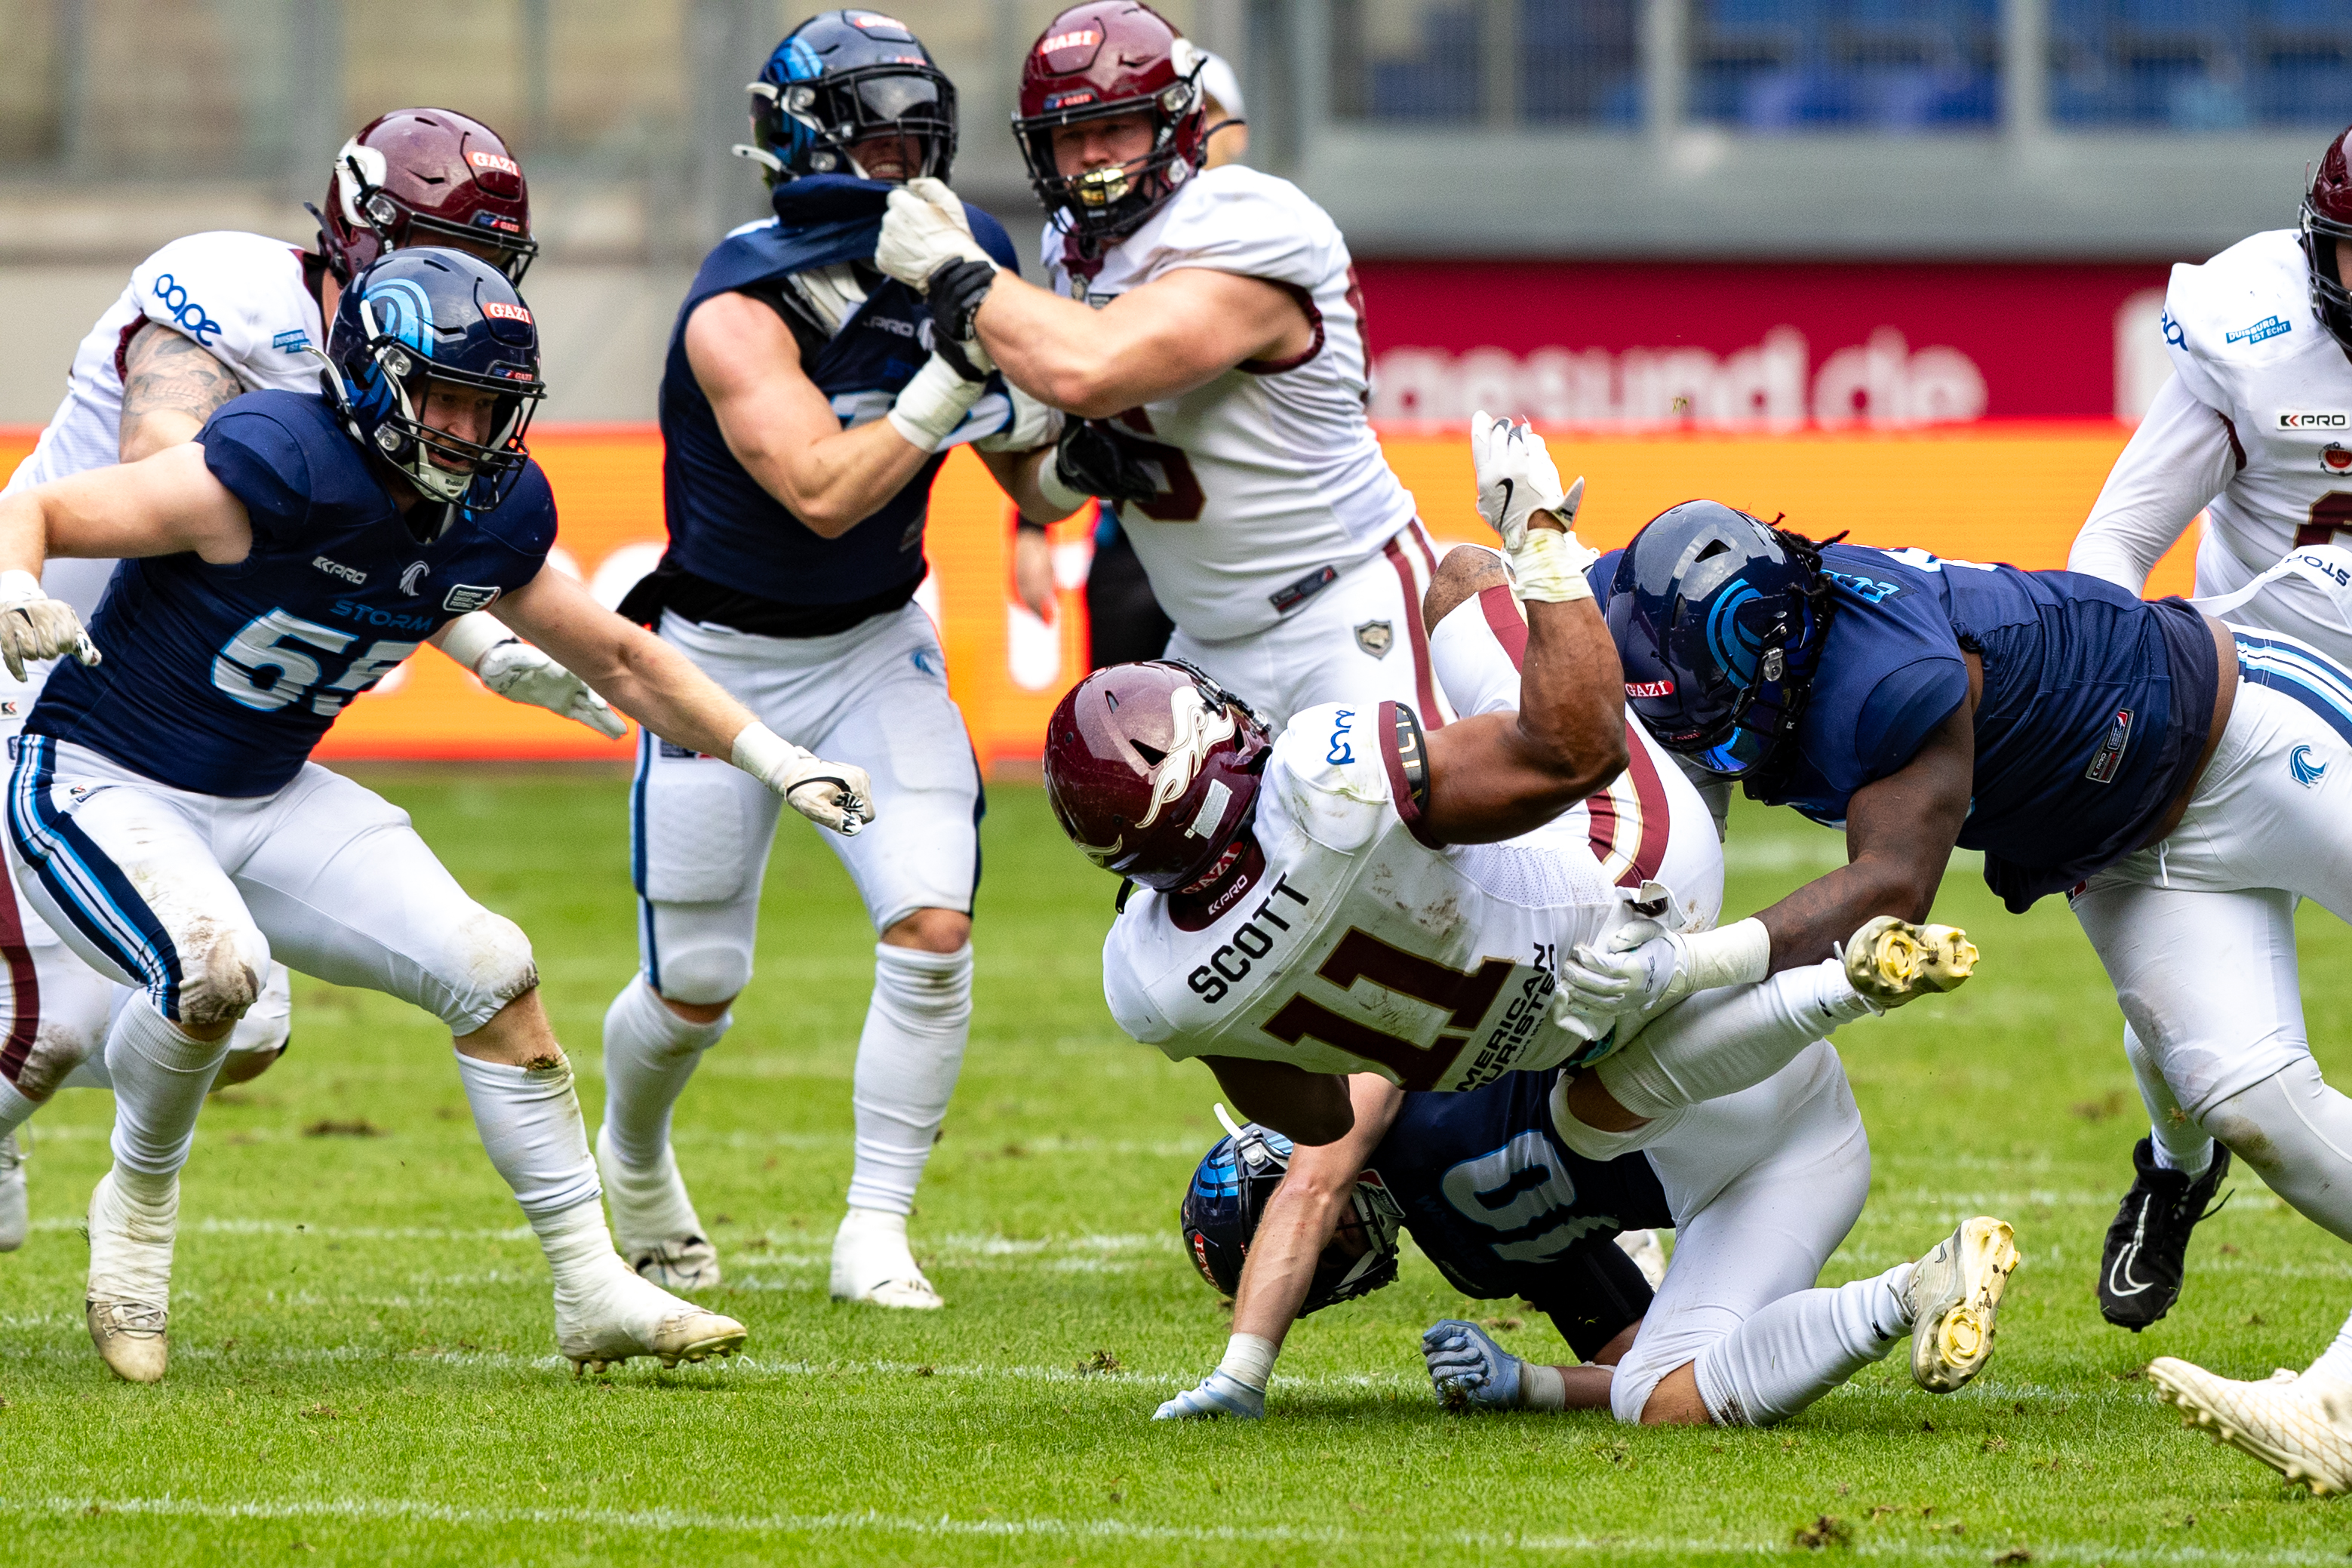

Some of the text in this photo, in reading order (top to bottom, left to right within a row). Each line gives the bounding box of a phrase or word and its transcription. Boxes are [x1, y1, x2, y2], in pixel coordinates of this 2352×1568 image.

[472, 152, 521, 177] GAZI
[152, 274, 222, 347] pape
[490, 303, 531, 324] GAZI
[2228, 318, 2277, 341] DUISBURG
[2252, 324, 2287, 342] IST ECHT
[329, 599, 434, 632] STORM
[1181, 850, 1239, 895] GAZI
[1188, 872, 1310, 1004] SCOTT
[1259, 925, 1516, 1092] 11
[1455, 942, 1548, 1092] MERICAN
